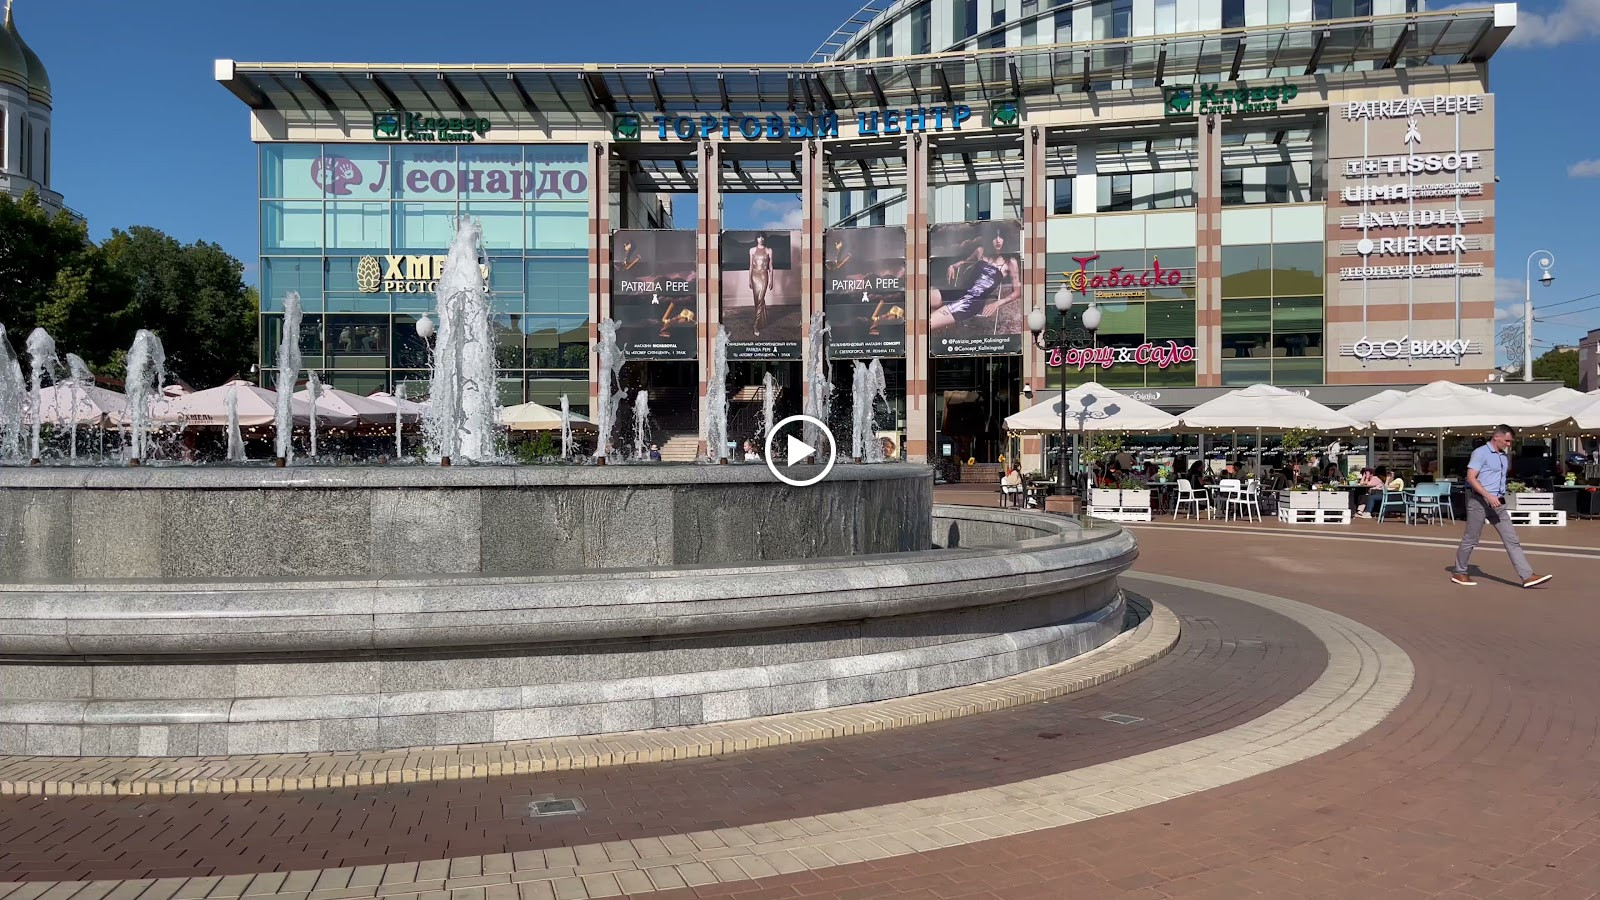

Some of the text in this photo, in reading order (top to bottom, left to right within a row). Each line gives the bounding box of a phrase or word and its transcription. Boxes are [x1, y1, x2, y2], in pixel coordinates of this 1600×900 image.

[1348, 94, 1478, 119] PATRIZIA PEPE
[653, 104, 972, 139] ТОРГОВЫЙ ЦЕНТР
[1381, 152, 1478, 172] TISSOT
[369, 160, 588, 200] Леонардо
[1357, 208, 1466, 227] INVIDIA
[1380, 235, 1467, 254] RIEKER
[621, 280, 689, 292] PATRIZIA PEPE
[832, 278, 899, 290] PATRIZIA PEPE
[1118, 347, 1131, 362] &
[1134, 340, 1194, 369] Сало
[1410, 339, 1471, 355] ВИЖУ
